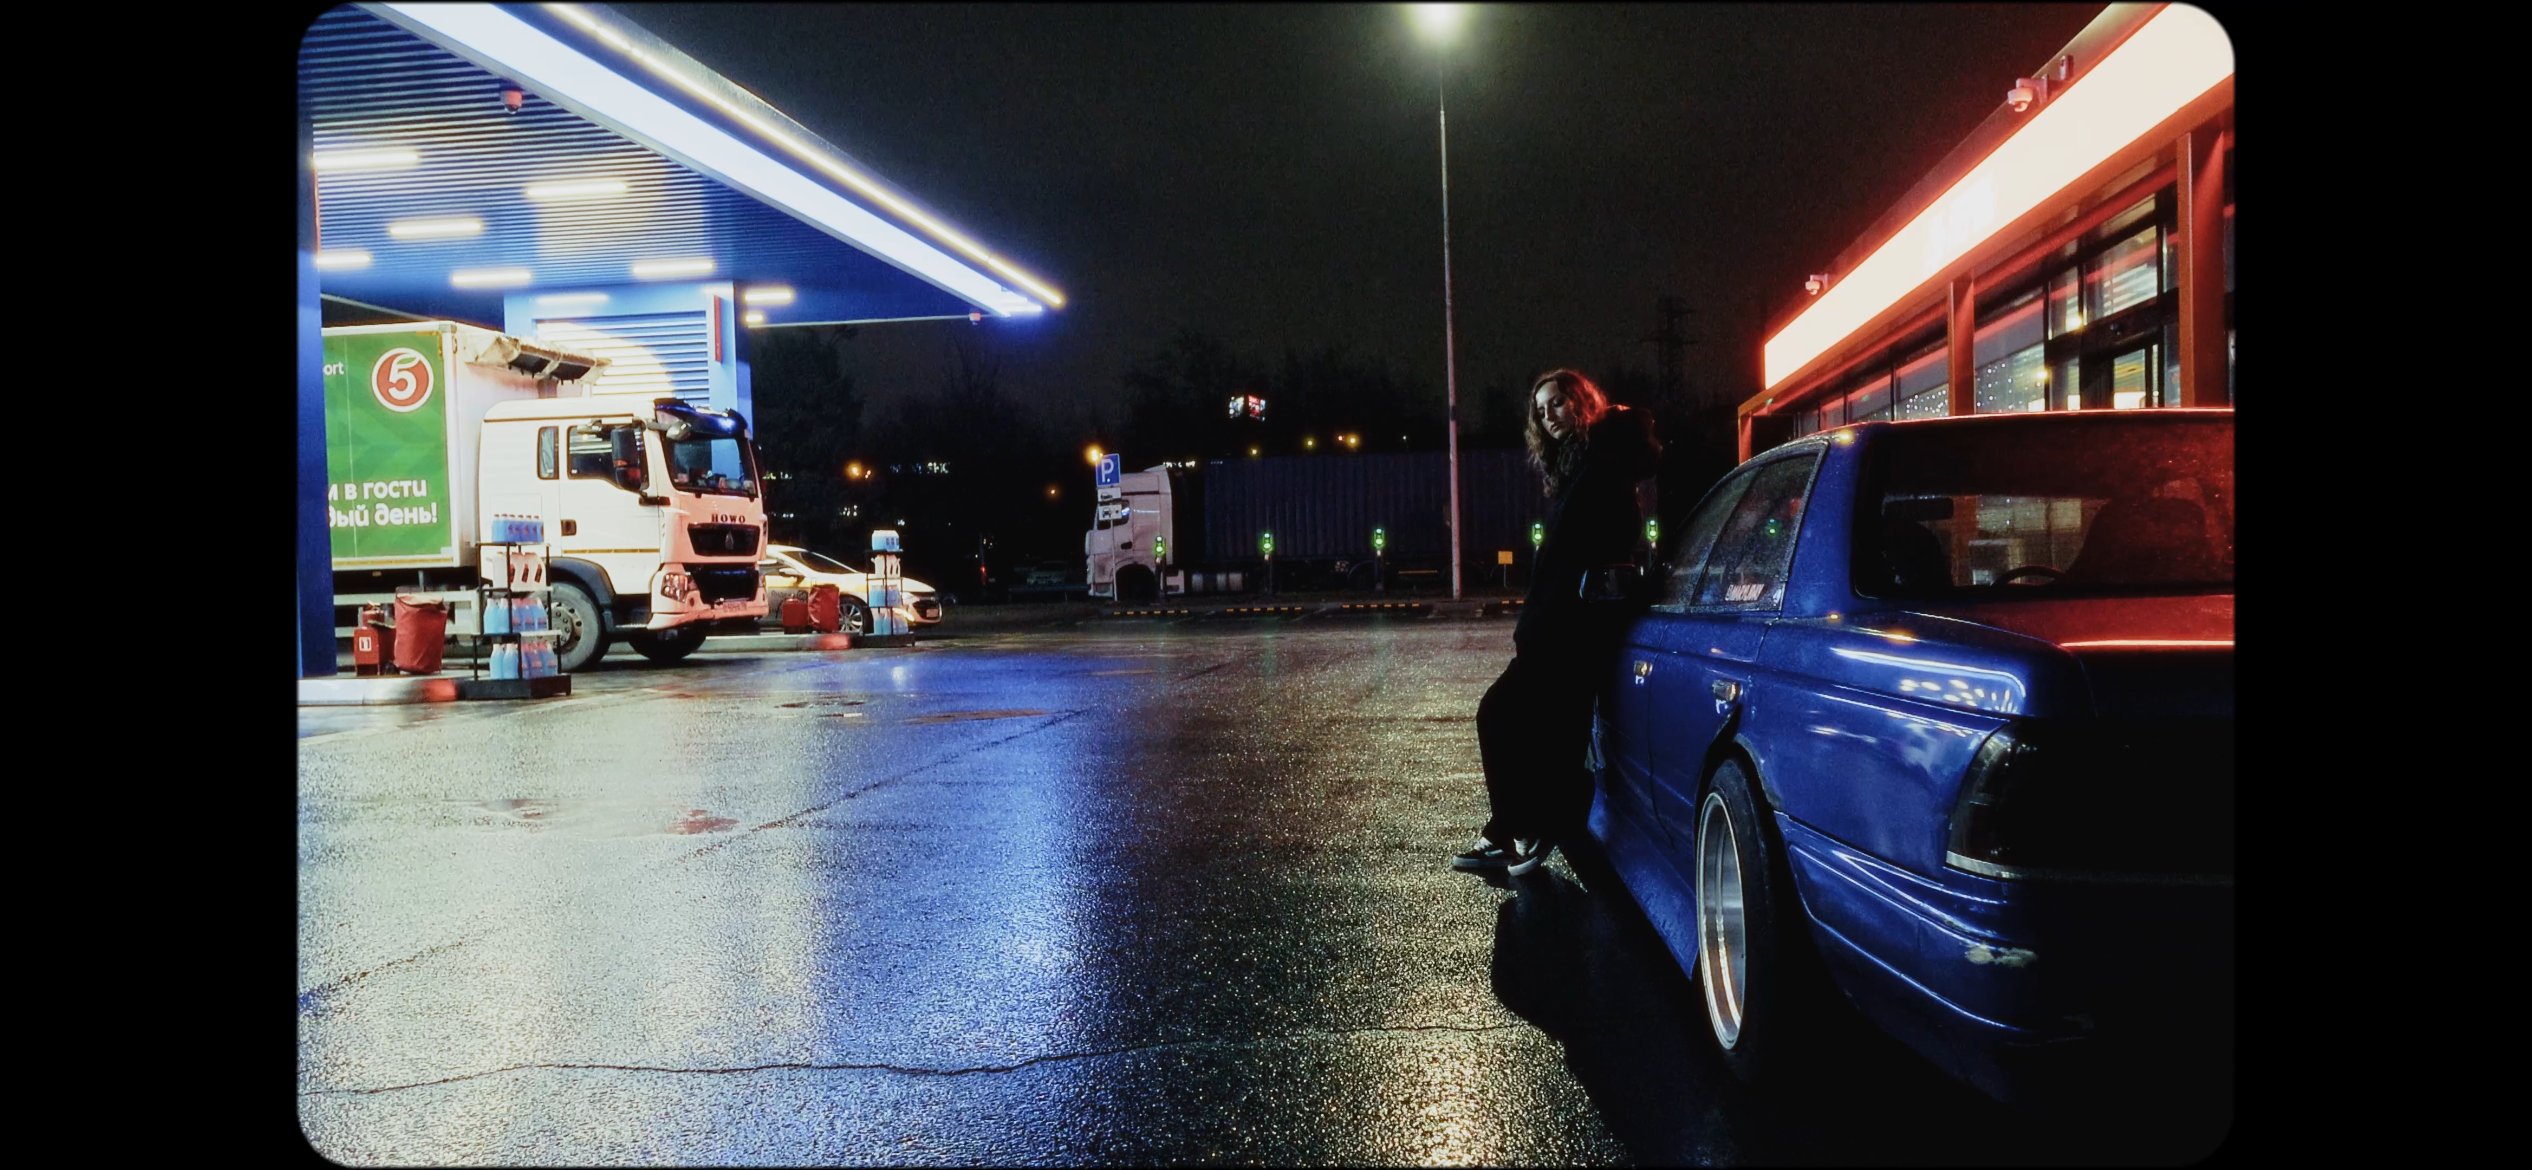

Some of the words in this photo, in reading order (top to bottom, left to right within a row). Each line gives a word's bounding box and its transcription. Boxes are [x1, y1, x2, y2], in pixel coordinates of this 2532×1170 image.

[388, 353, 420, 400] 5
[1101, 459, 1114, 483] P
[344, 483, 358, 500] в
[363, 480, 427, 499] гости
[374, 502, 438, 526] день!
[711, 513, 746, 524] HOWO
